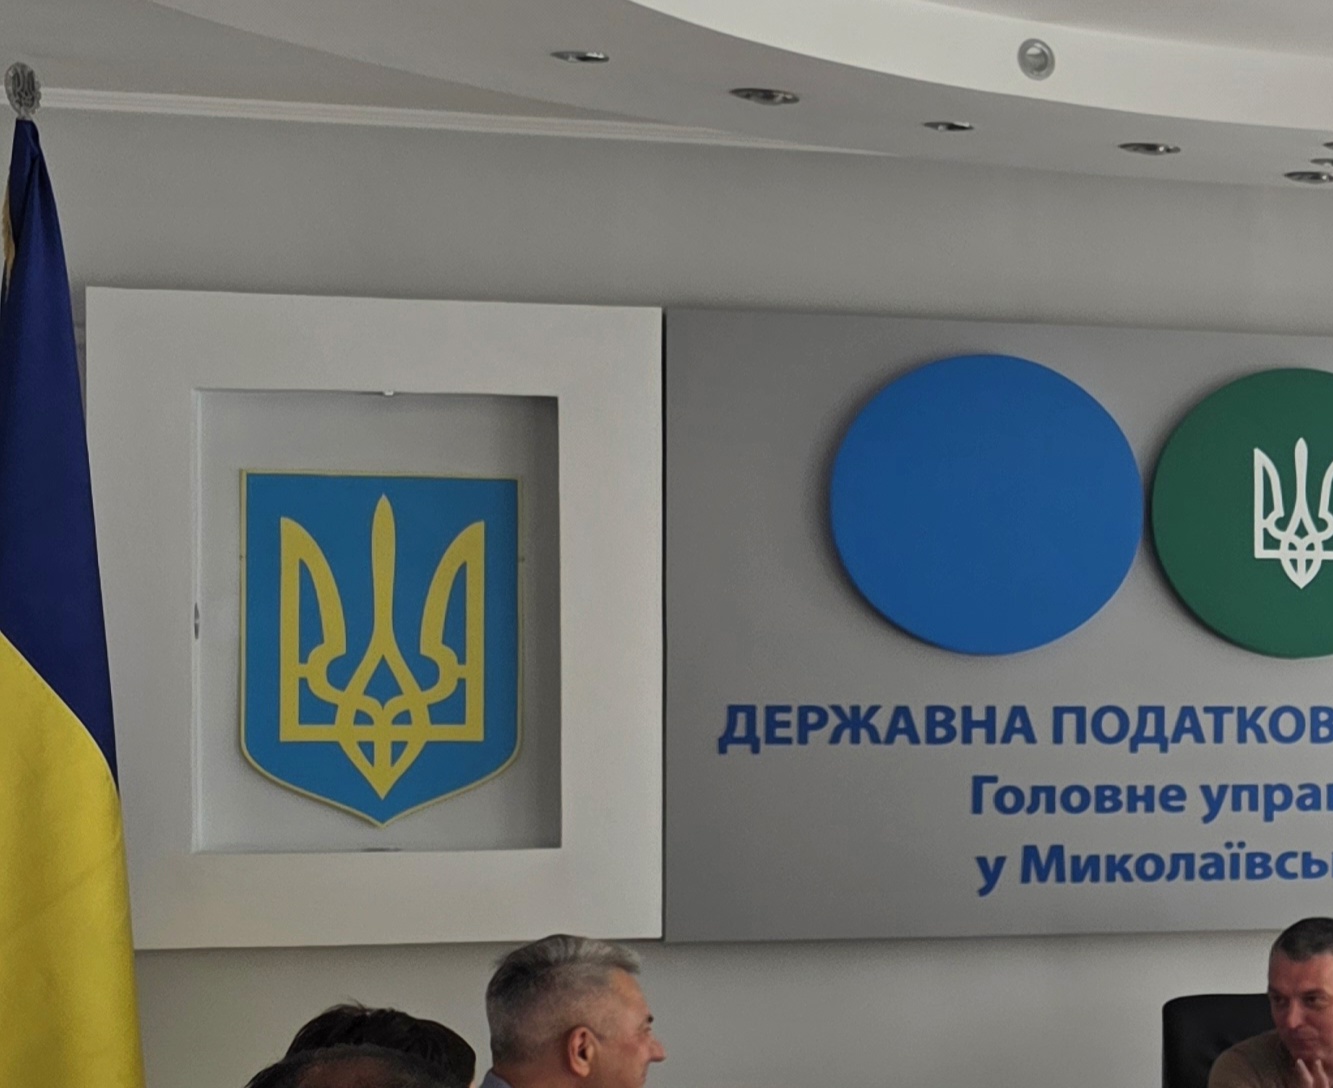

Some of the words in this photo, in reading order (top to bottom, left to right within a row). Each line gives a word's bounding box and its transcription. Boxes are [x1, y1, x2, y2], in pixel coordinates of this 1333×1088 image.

[719, 705, 1035, 753] ДЕРЖАВНА
[973, 776, 1186, 814] Головне
[977, 857, 1004, 896] у
